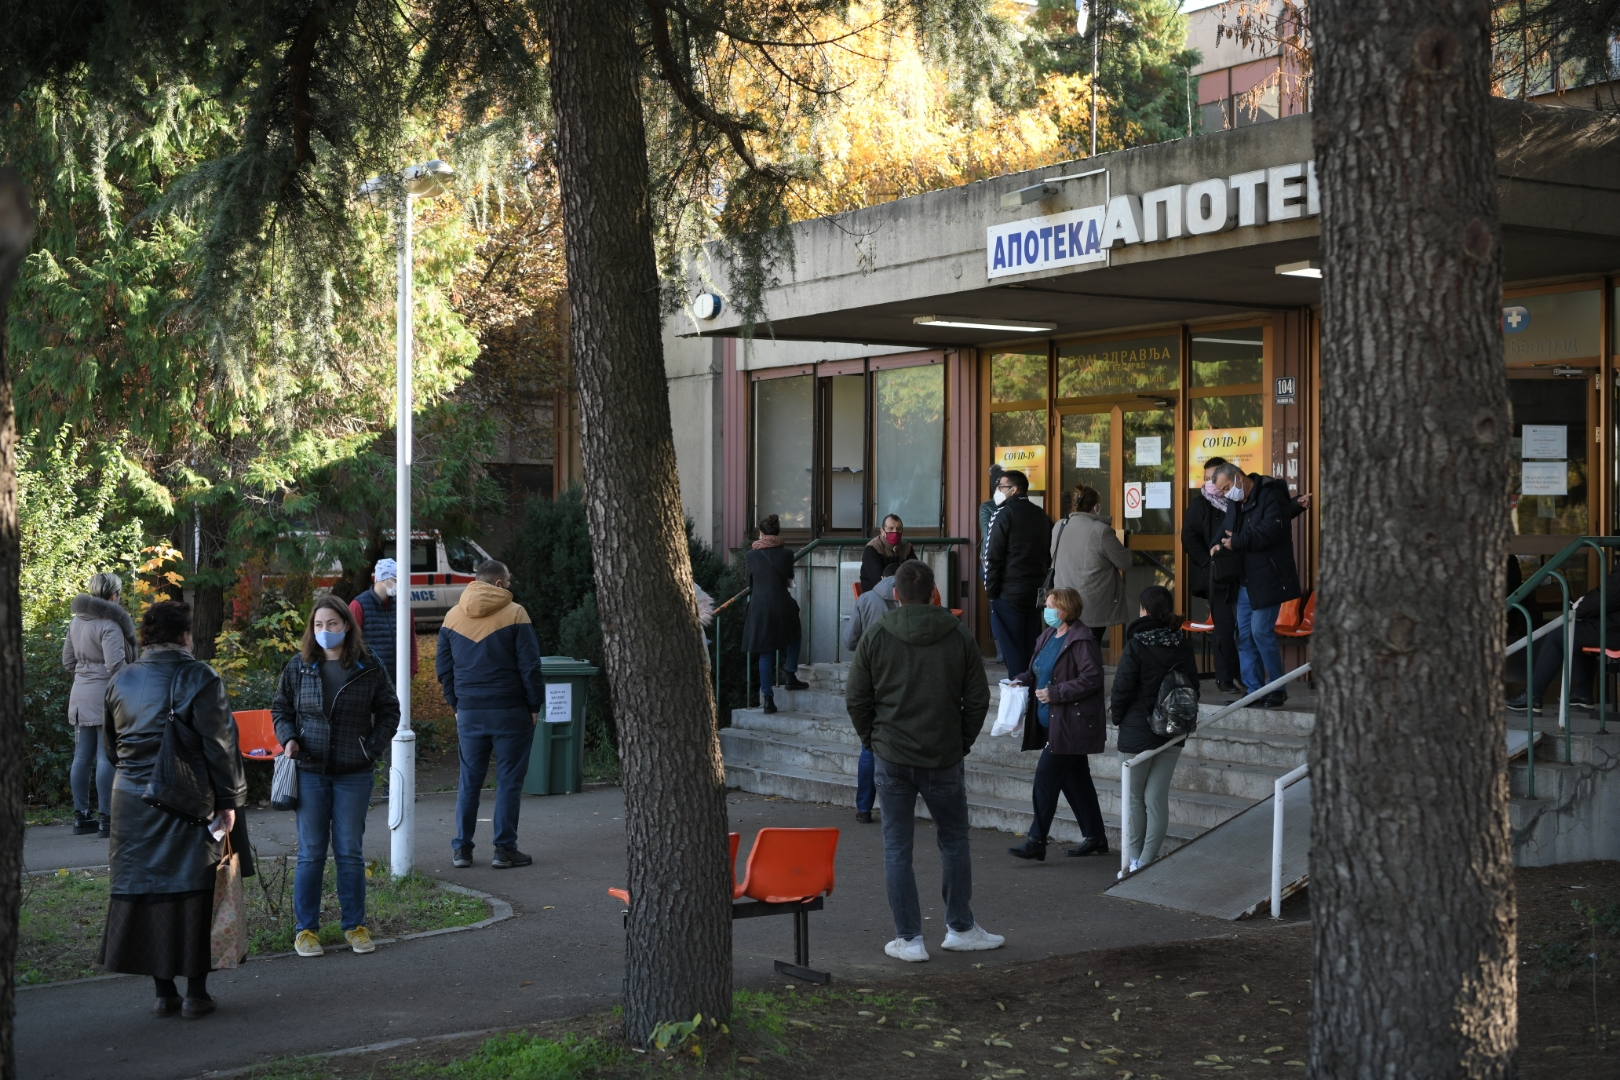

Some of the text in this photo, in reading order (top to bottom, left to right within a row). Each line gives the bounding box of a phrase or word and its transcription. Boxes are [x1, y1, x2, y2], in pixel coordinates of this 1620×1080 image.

[993, 218, 1101, 270] АПОТЕКА
[1510, 337, 1578, 356] Београд
[1102, 347, 1170, 363] ЗДРАВЉА
[1277, 378, 1293, 395] 104
[1202, 435, 1248, 448] COVID-19
[1003, 451, 1036, 461] COVID-19
